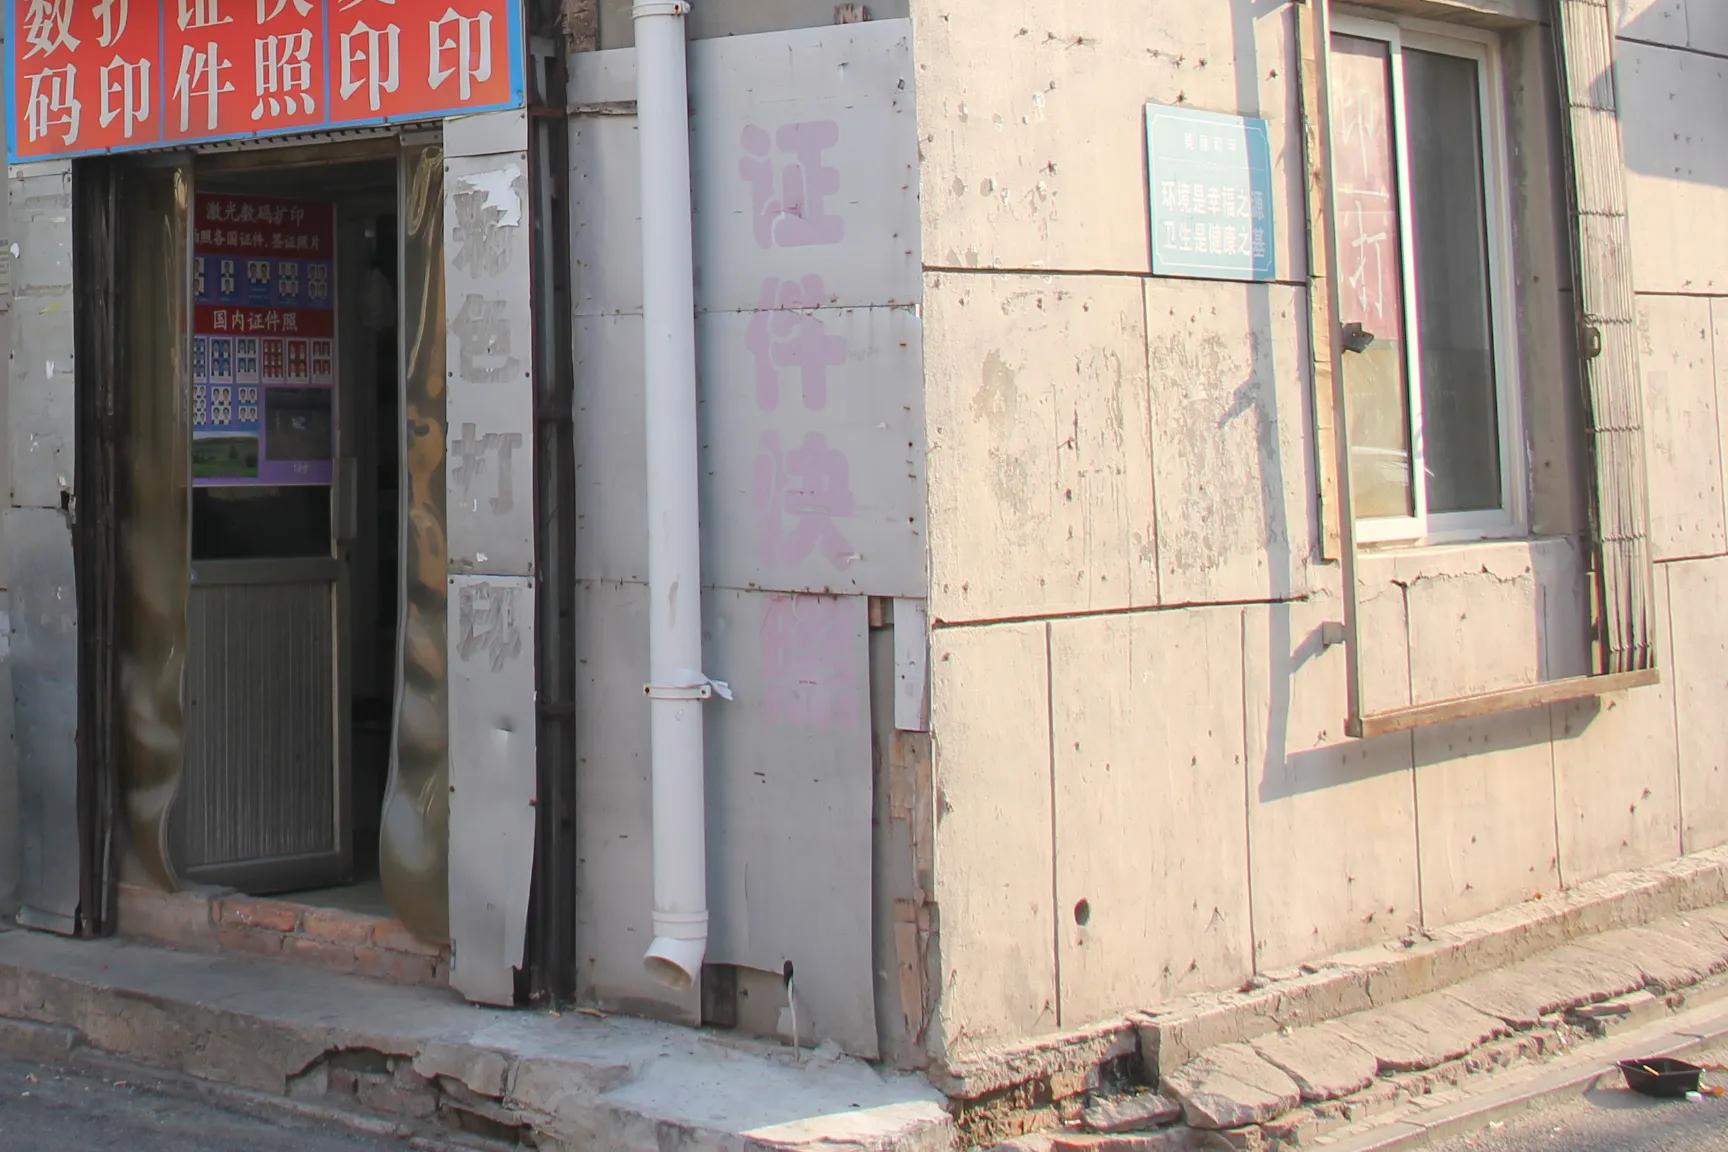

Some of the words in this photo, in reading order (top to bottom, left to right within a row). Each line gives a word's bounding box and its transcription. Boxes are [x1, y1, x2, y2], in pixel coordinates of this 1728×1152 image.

[206, 200, 305, 226] 激光数码扩印
[1162, 220, 1266, 258] 卫生是健康之基
[212, 308, 299, 333] 国内证件照
